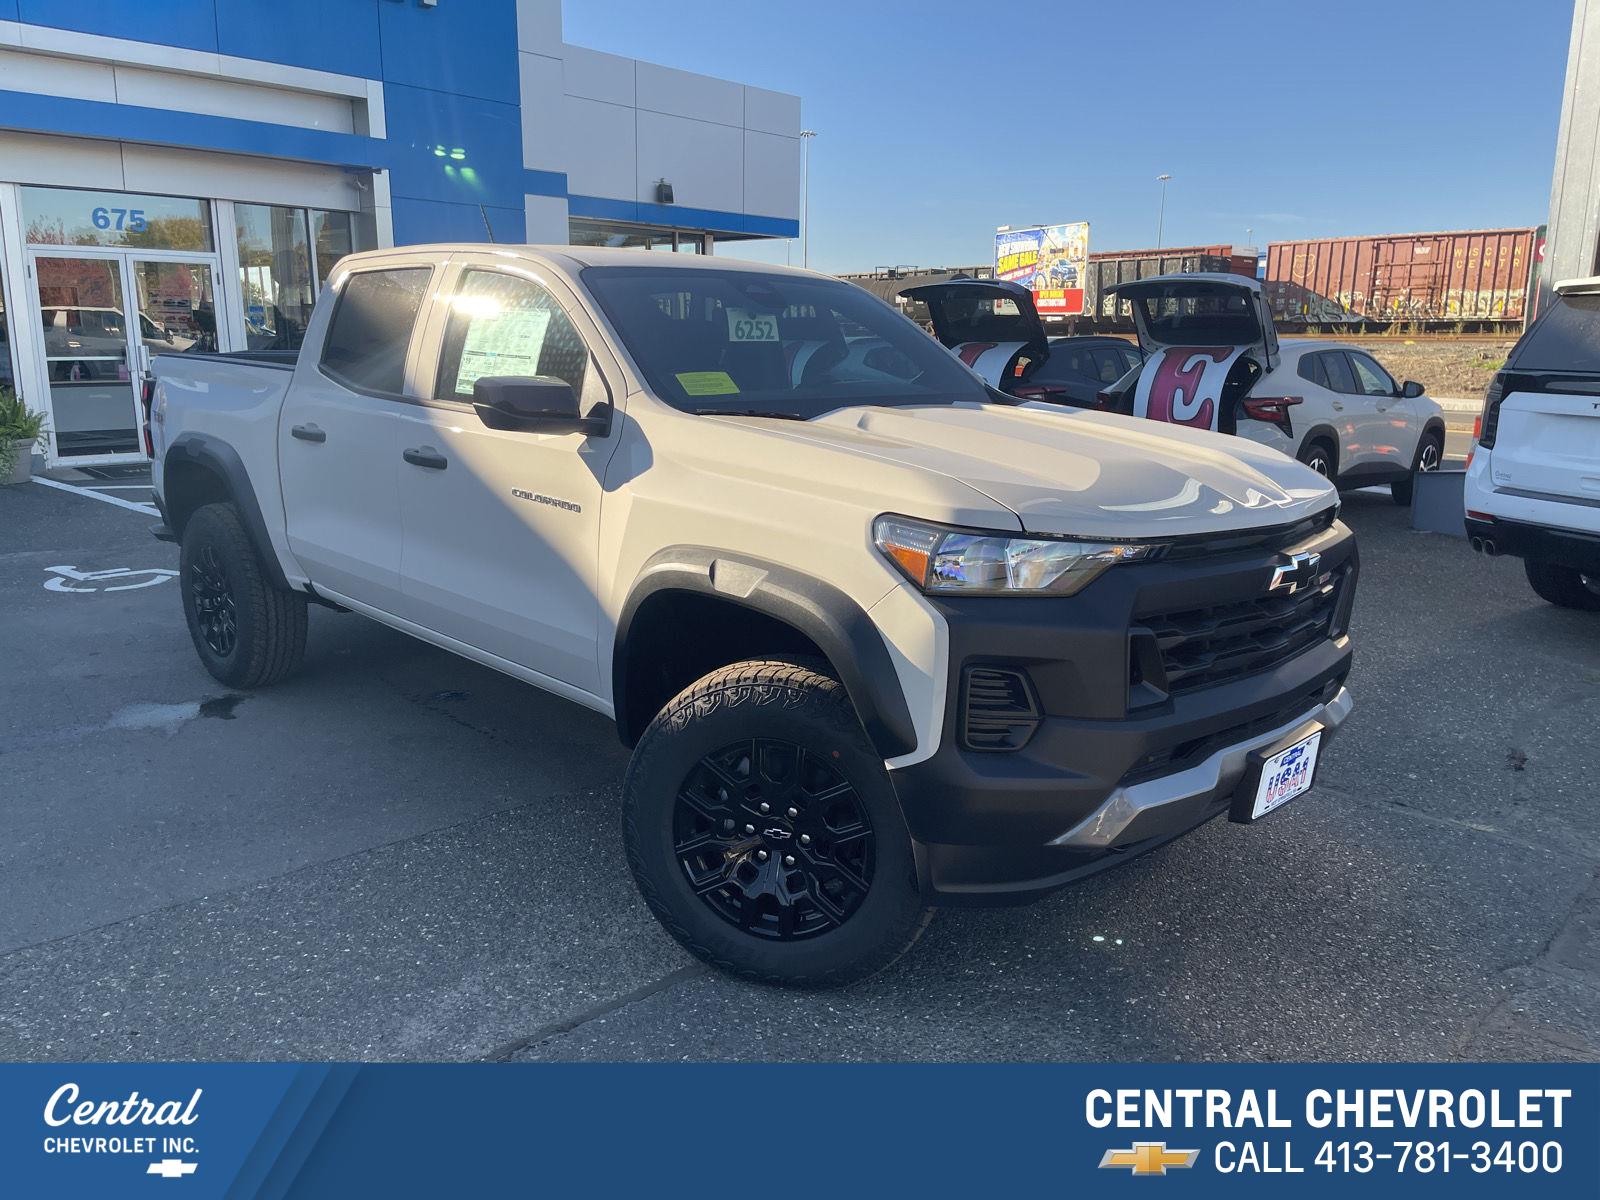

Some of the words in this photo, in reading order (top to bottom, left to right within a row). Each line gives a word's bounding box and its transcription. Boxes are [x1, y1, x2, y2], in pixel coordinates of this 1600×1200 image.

[92, 207, 148, 233] 675
[734, 320, 775, 340] 6252
[511, 488, 582, 513] COLORADO
